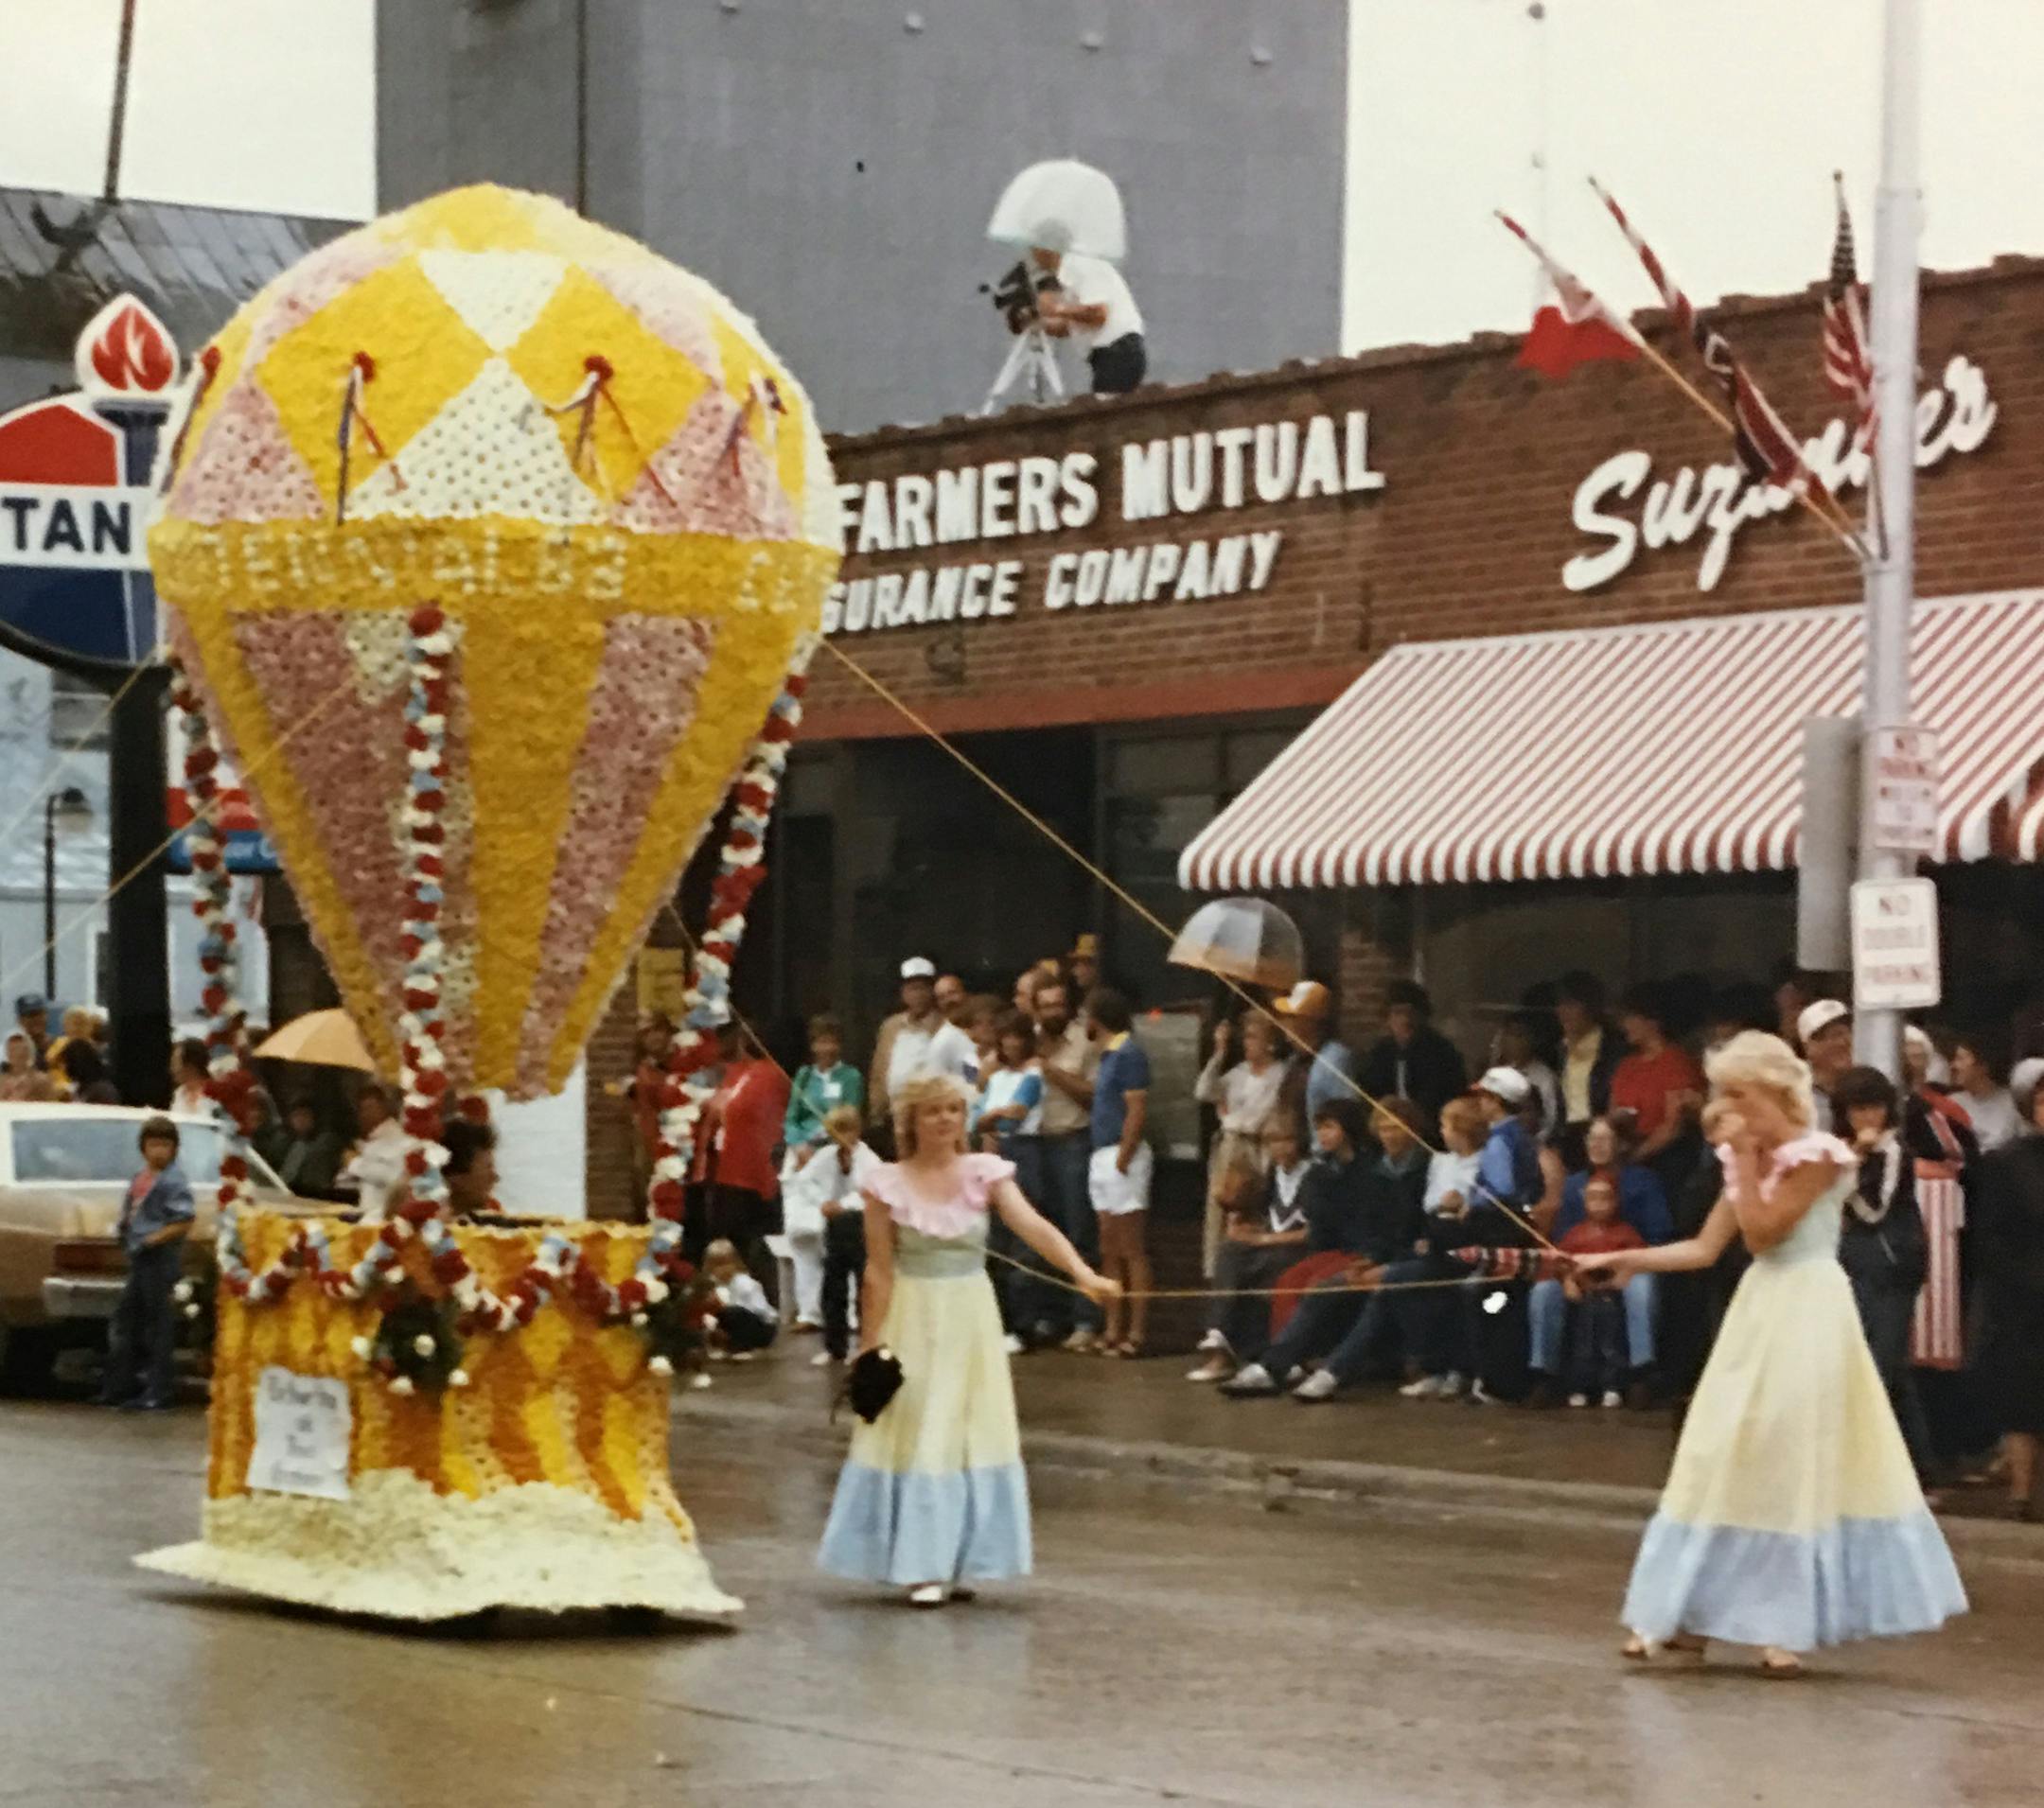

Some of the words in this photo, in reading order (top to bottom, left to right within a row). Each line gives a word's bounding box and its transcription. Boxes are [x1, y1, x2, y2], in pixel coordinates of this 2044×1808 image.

[837, 452, 1099, 554] FARMERS
[1121, 411, 1385, 520] MUTUAL
[1, 496, 132, 554] TAN
[821, 560, 1024, 634] SURANCE
[1045, 531, 1283, 609] COMPANY
[1878, 895, 1911, 918] NO
[1860, 963, 1930, 985] PARKING
